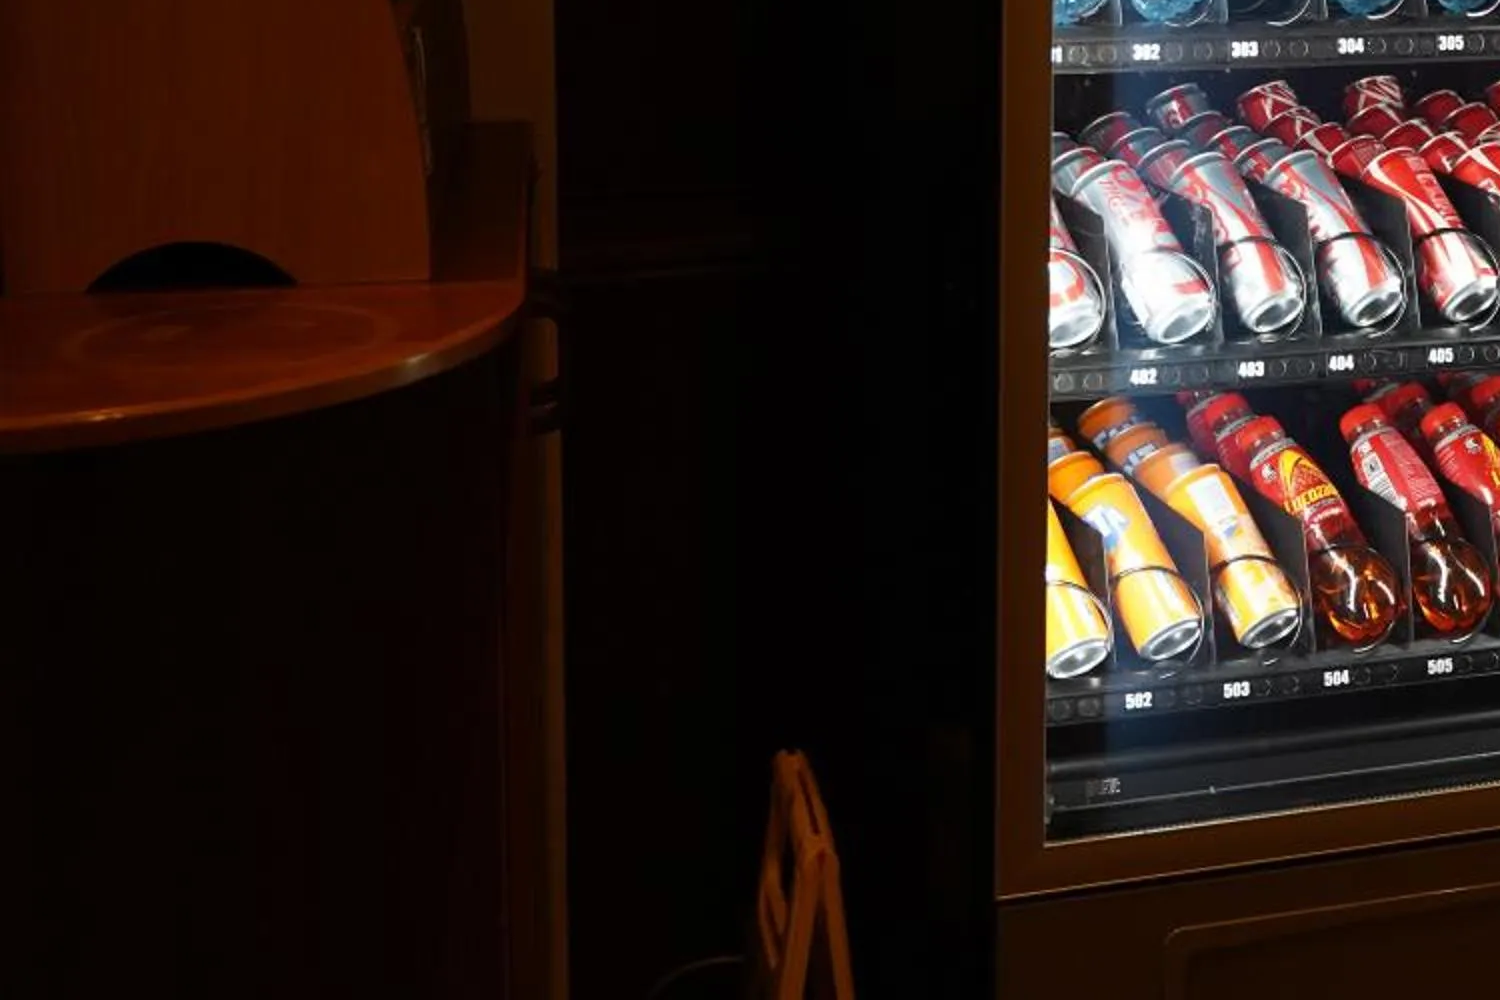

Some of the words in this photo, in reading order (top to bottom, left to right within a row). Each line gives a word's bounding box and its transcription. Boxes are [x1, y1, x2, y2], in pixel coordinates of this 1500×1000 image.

[1337, 37, 1365, 55] 304
[1438, 35, 1465, 51] 305
[1328, 354, 1355, 371] 404
[1428, 347, 1454, 364] 405
[1128, 367, 1158, 386] 402
[1427, 657, 1453, 675] 505
[1323, 669, 1350, 687] 504
[1223, 681, 1250, 699] 503
[1125, 691, 1153, 710] 502
